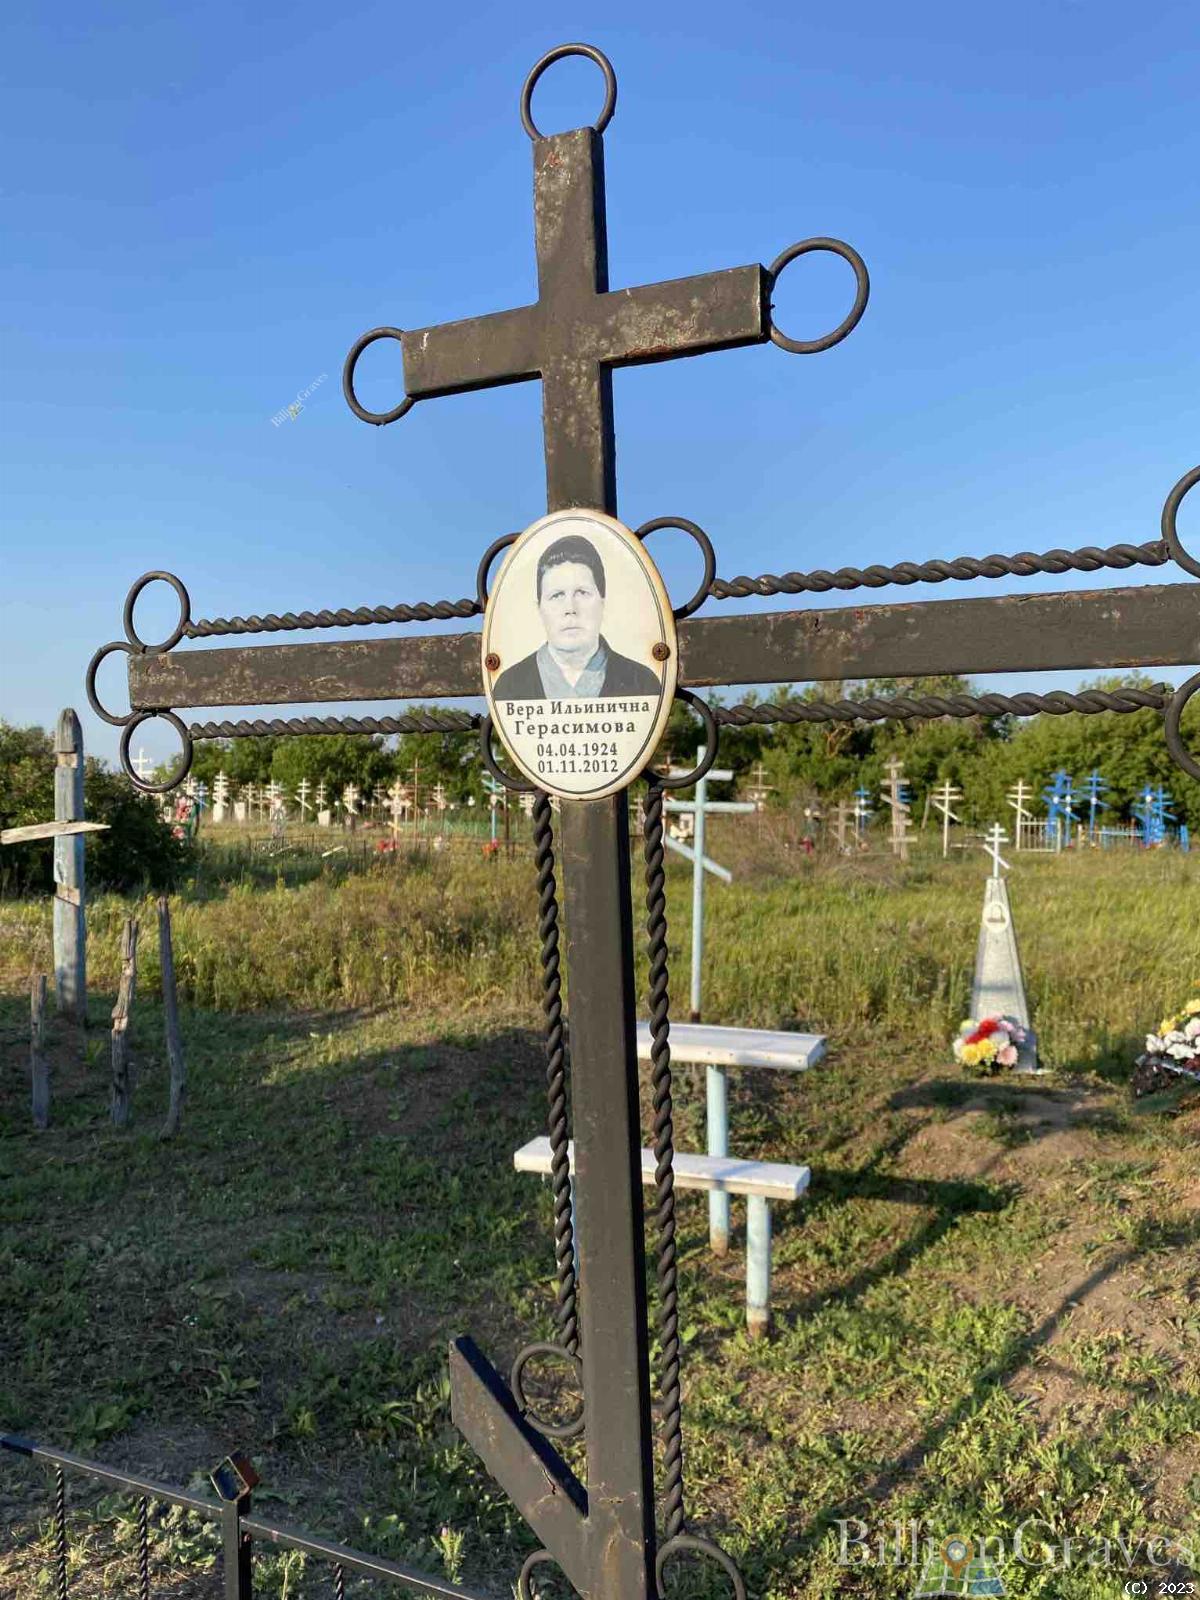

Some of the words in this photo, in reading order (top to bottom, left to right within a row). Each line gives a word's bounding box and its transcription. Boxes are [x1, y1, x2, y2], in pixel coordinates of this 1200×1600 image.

[506, 702, 544, 719] Вера
[551, 701, 650, 715] Ильинична
[515, 721, 636, 739] Герасимова
[537, 742, 618, 757] 04.04.1924
[538, 759, 619, 773] 01.11.2012
